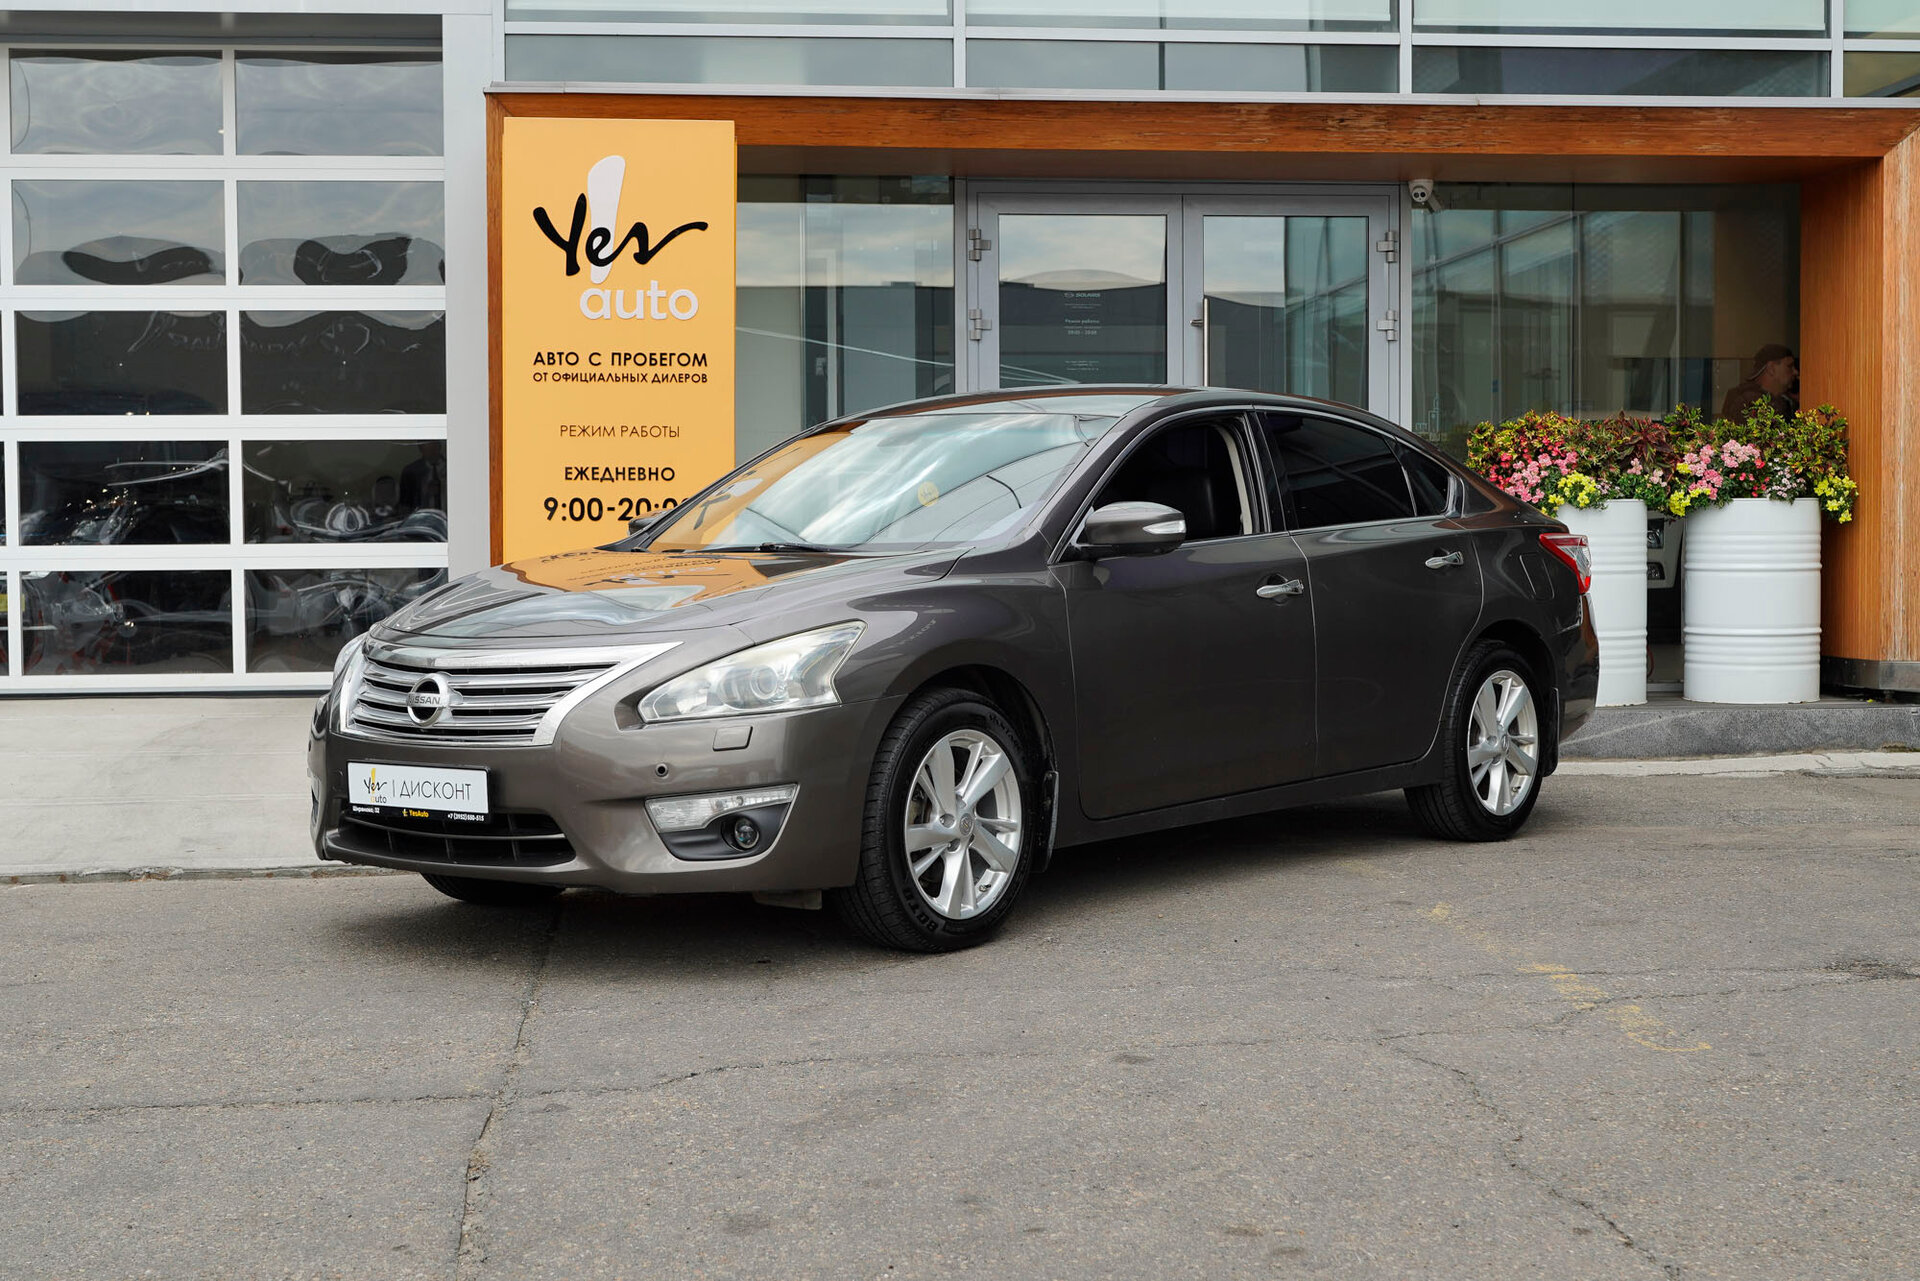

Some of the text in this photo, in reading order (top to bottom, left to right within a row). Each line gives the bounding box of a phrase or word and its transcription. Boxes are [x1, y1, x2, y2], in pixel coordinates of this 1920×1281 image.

[532, 192, 709, 277] Yes
[579, 280, 699, 320] auto
[533, 351, 580, 366] АВТО
[611, 352, 708, 367] ПРОБЕГОМ
[532, 372, 708, 384] ОТ ОФИЦИАЛЬНЫХ ДИЛЕРОВ
[560, 424, 680, 438] РЕЖИМ РАБОТЫ
[564, 466, 675, 483] ЕЖЕДНЕВНО
[400, 780, 472, 801] ДИСКОНТ
[370, 794, 387, 804] auto
